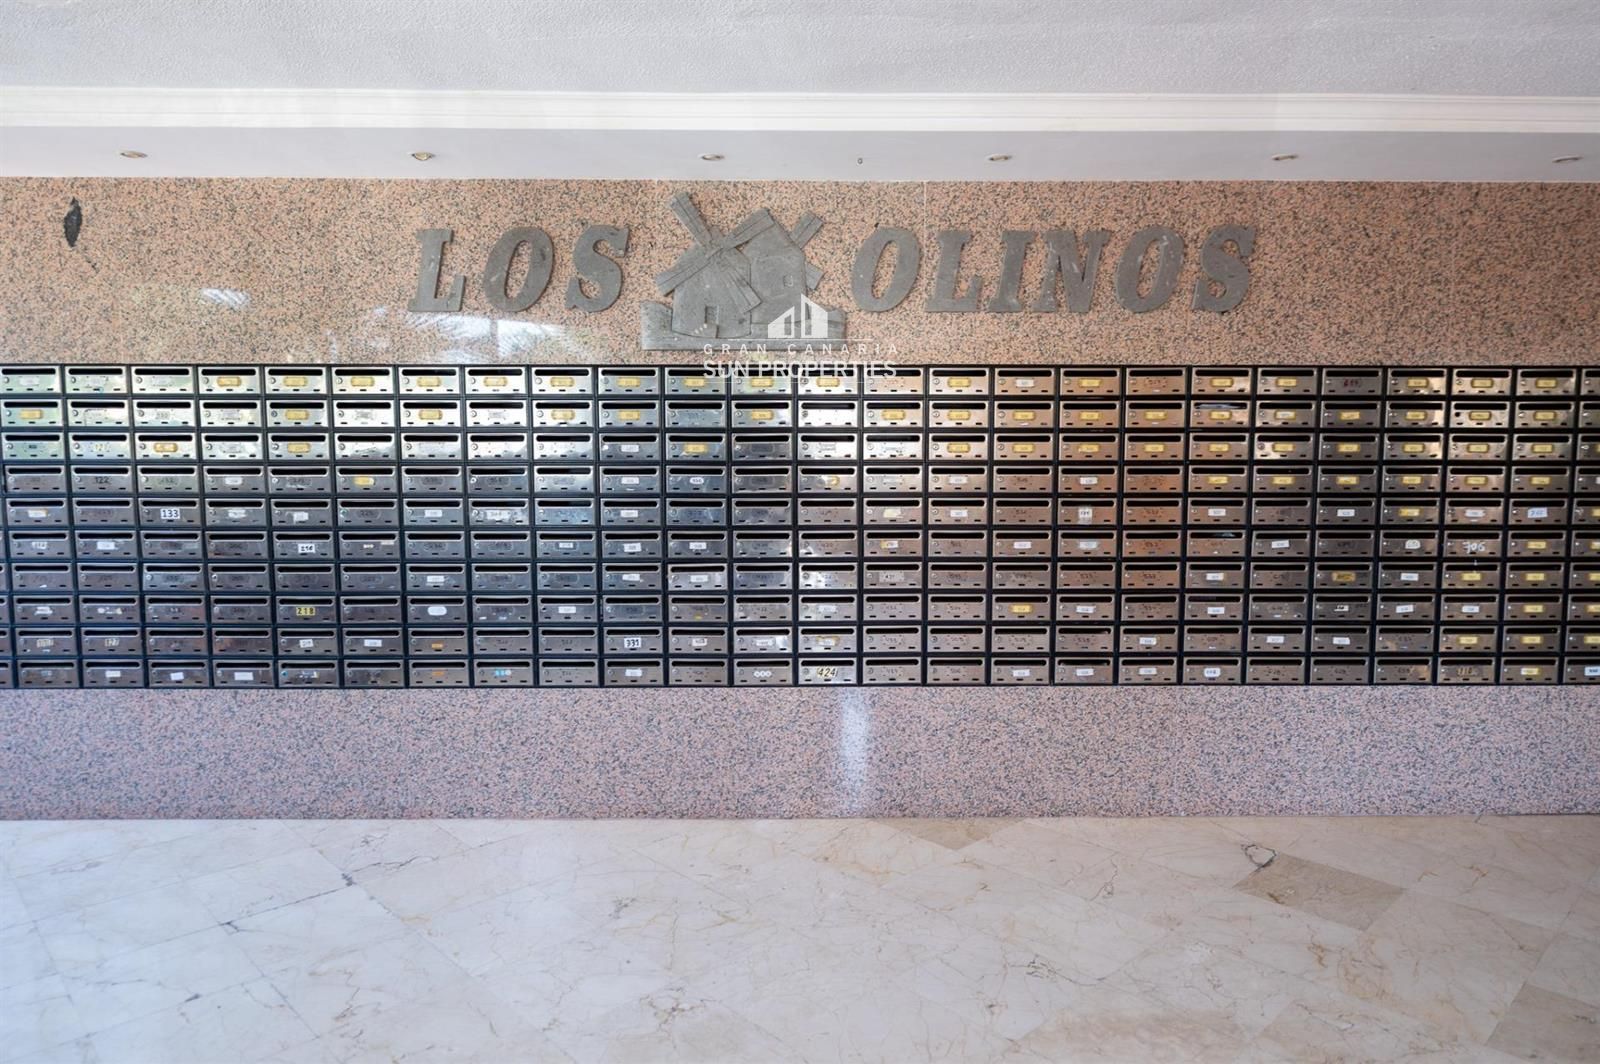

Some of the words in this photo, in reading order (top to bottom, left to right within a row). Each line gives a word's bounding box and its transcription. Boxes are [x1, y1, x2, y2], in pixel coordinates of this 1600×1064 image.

[408, 224, 629, 313] LOS
[851, 224, 1256, 313] OLINOS
[94, 476, 109, 485] 122
[162, 508, 179, 518] 133
[298, 607, 314, 615] 218
[625, 639, 639, 648] 331
[817, 667, 836, 677] 424
